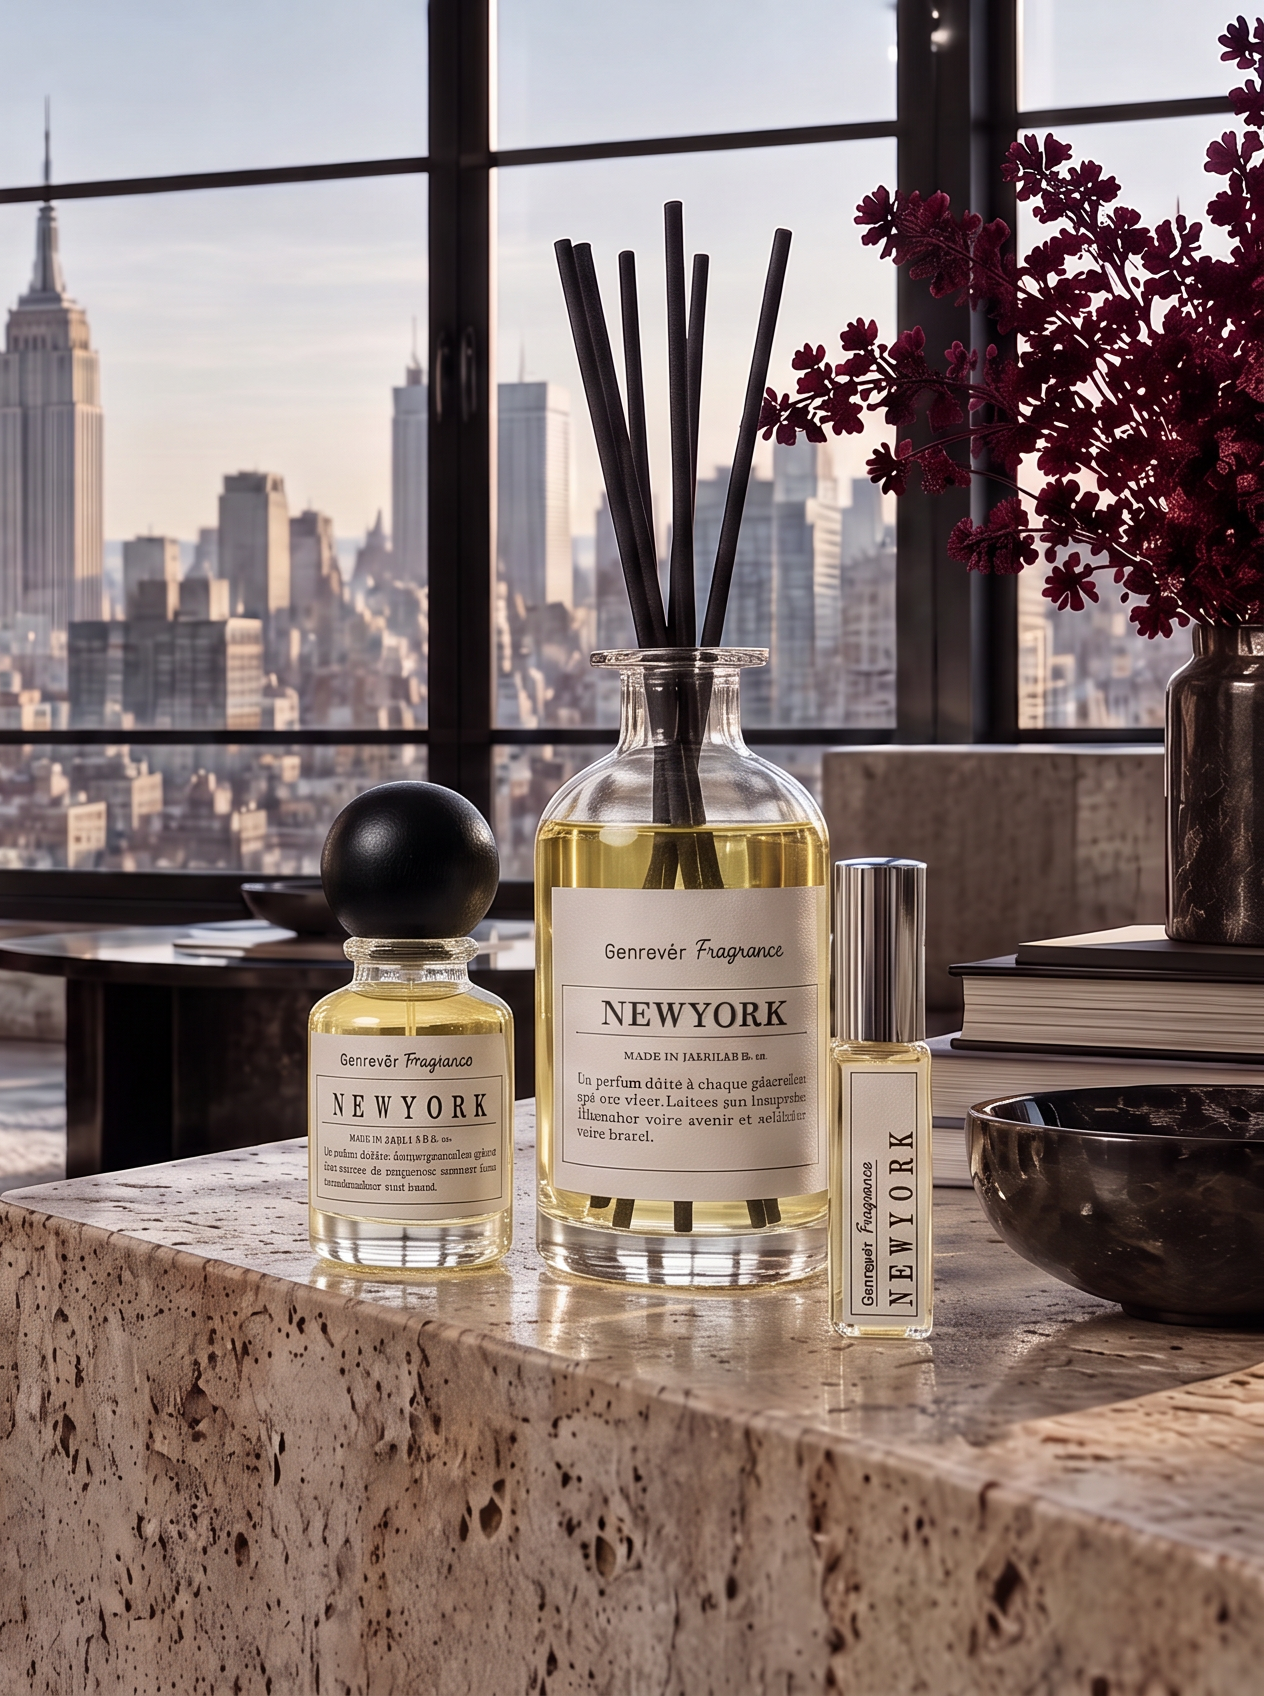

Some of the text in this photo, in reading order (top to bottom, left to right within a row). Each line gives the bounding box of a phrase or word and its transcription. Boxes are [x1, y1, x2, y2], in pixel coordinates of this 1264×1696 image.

[604, 938, 784, 965] Genrevér Fragrance
[601, 999, 788, 1028] NEWYORK
[623, 1051, 661, 1061] MADE
[664, 1052, 679, 1062] IN
[595, 1075, 642, 1091] perfum
[686, 1078, 695, 1090] à
[698, 1077, 748, 1094] chaque
[332, 1092, 487, 1120] NEWYORK
[645, 1114, 683, 1126] voire
[688, 1114, 734, 1126] avenir
[738, 1114, 753, 1126] et
[577, 1126, 606, 1140] veire
[888, 1130, 914, 1308] NEWYORK
